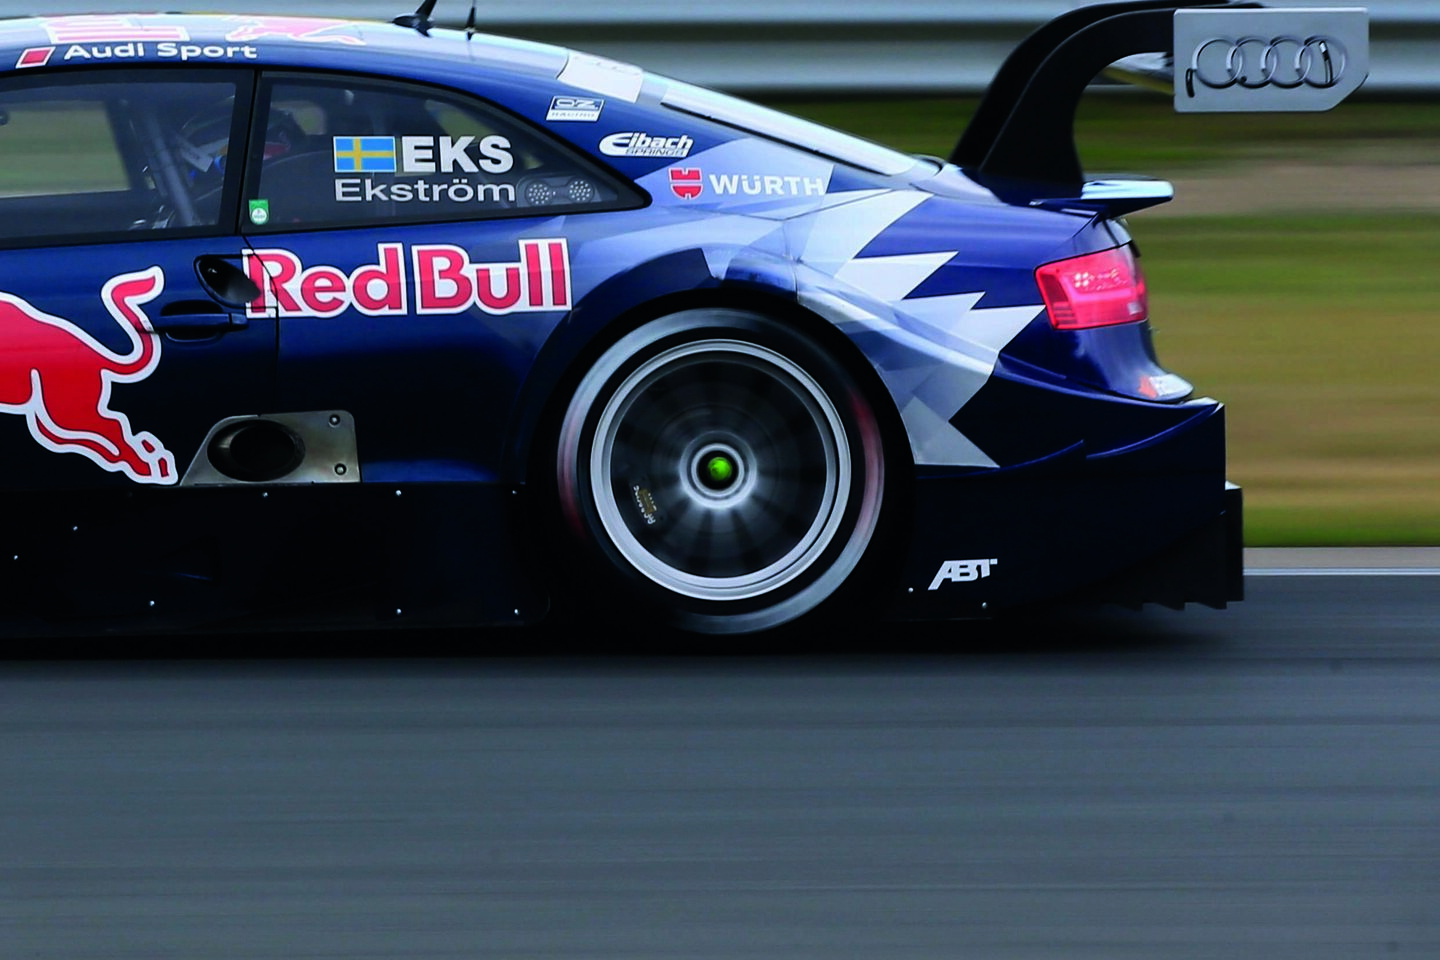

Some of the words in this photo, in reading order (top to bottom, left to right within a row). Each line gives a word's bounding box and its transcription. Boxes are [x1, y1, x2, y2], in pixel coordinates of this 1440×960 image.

[64, 43, 144, 60] Audi
[157, 43, 257, 60] Sport
[401, 135, 514, 173] EKS
[599, 133, 693, 156] Eibach
[334, 178, 516, 202] Ekström
[709, 174, 826, 196] WÜRTH
[244, 243, 408, 318] Red
[411, 238, 573, 315] Bull
[927, 558, 998, 591] ABT
